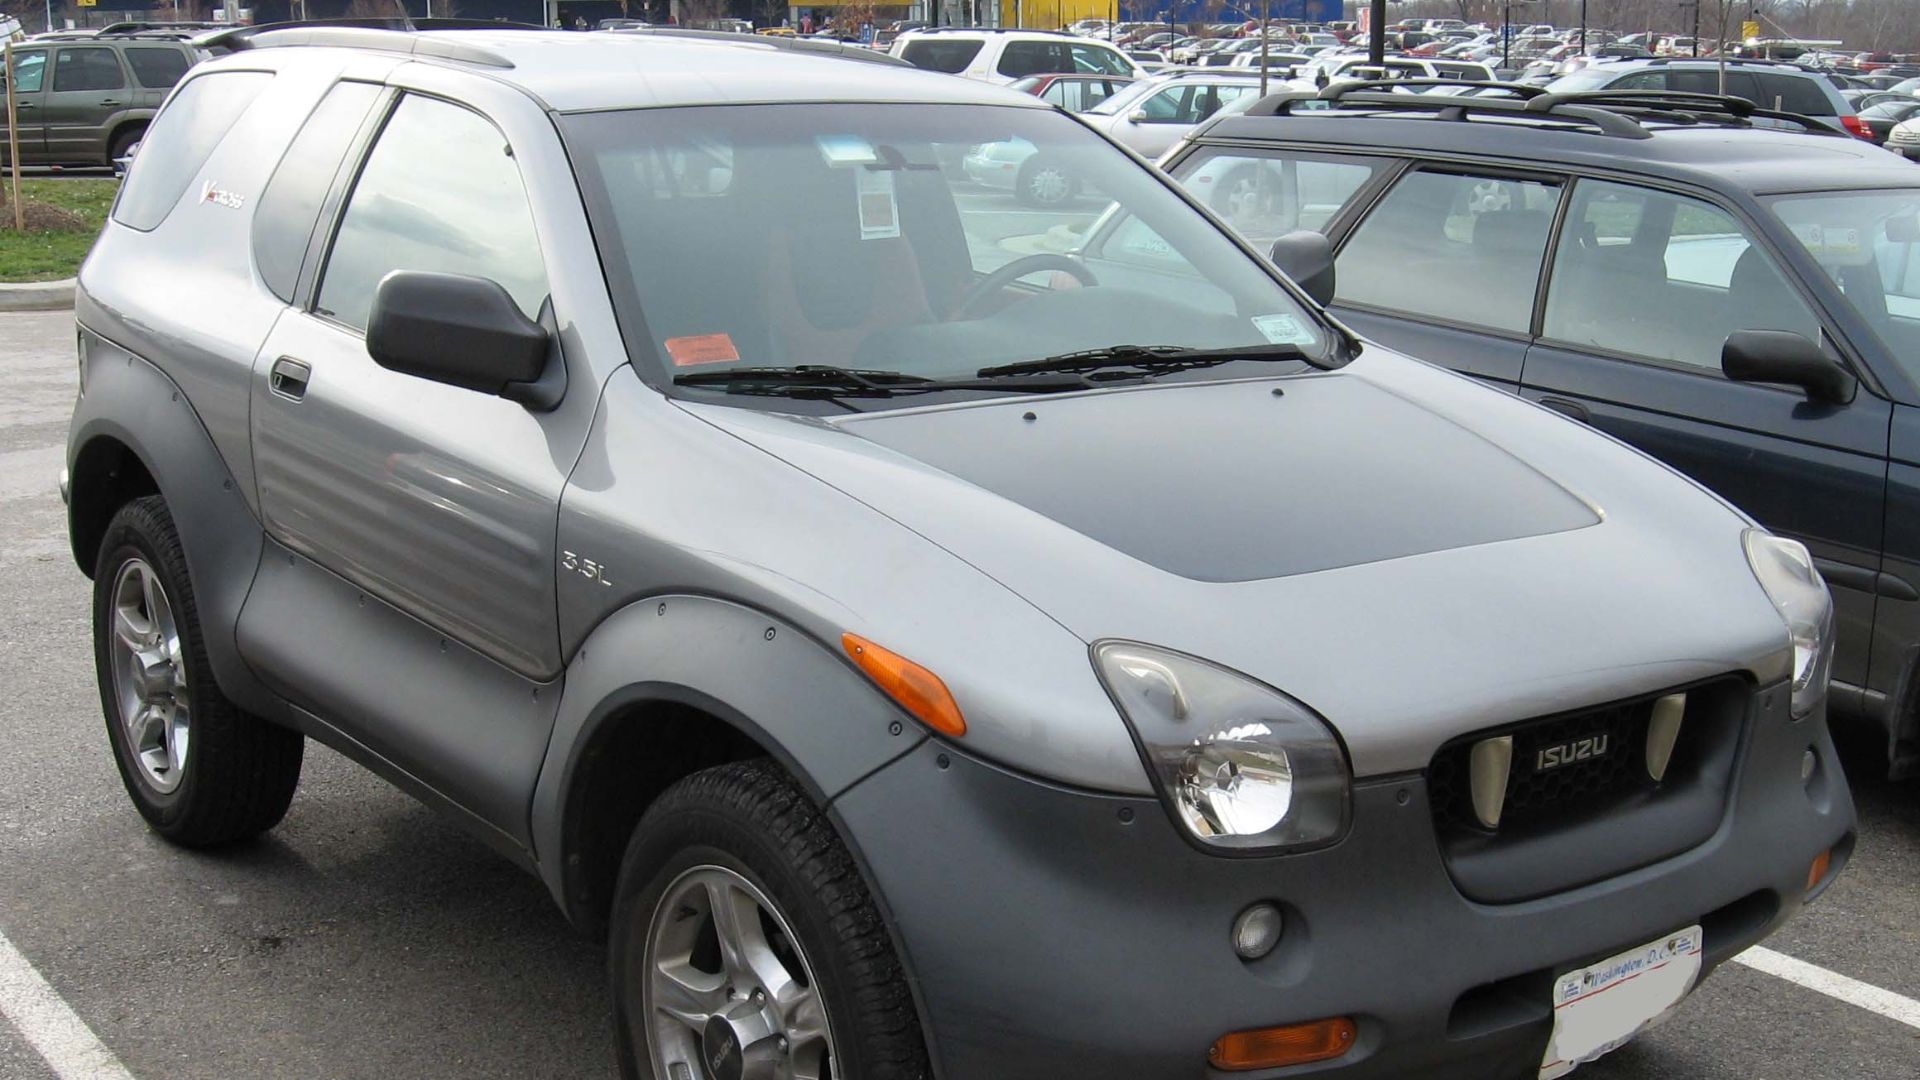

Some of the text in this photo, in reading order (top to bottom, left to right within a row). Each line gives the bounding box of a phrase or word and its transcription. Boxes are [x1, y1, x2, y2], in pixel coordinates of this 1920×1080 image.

[562, 550, 612, 586] 3.5L
[1537, 734, 1608, 770] ISUZU
[713, 1035, 734, 1070] ISUZU
